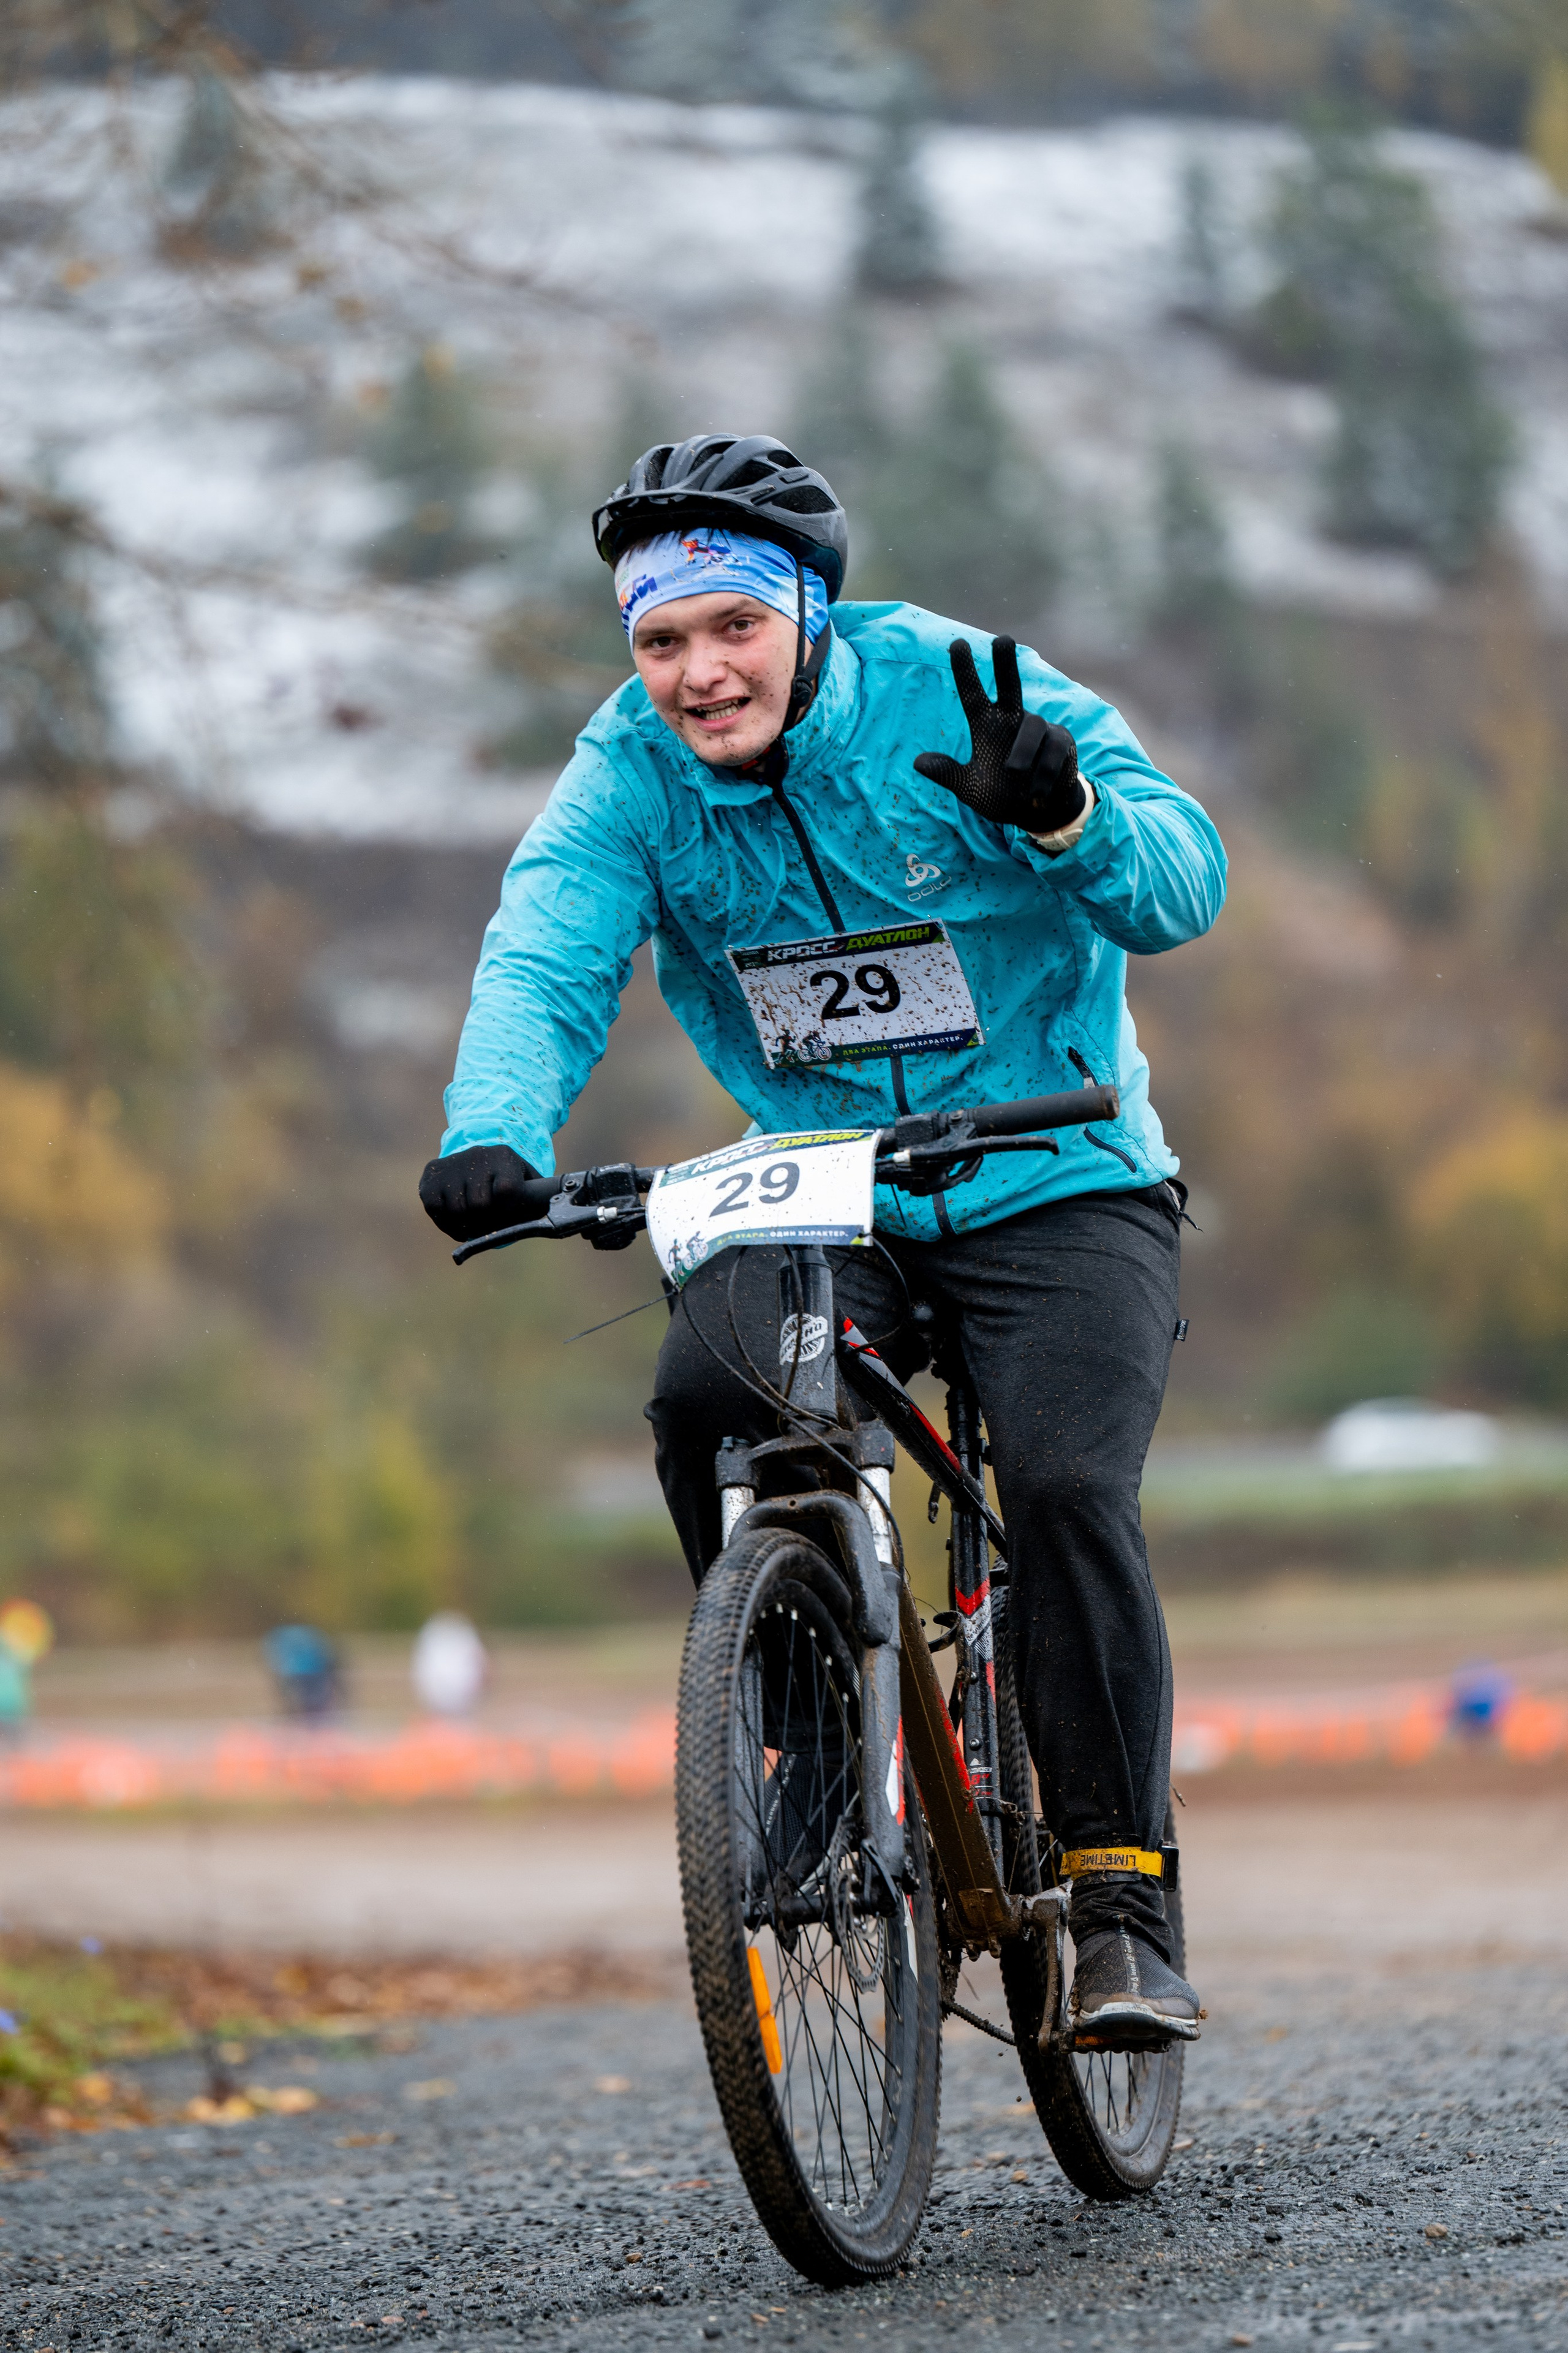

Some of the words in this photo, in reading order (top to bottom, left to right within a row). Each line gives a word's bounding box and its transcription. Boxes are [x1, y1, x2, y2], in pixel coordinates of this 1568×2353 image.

[767, 941, 839, 961] КРОСС
[846, 927, 930, 950] ДУАТЛОН
[810, 964, 901, 1019] 29
[769, 1133, 864, 1150] ДУАТЛОН
[709, 1161, 800, 1218] 29
[1080, 1853, 1136, 1867] LIMETIME
